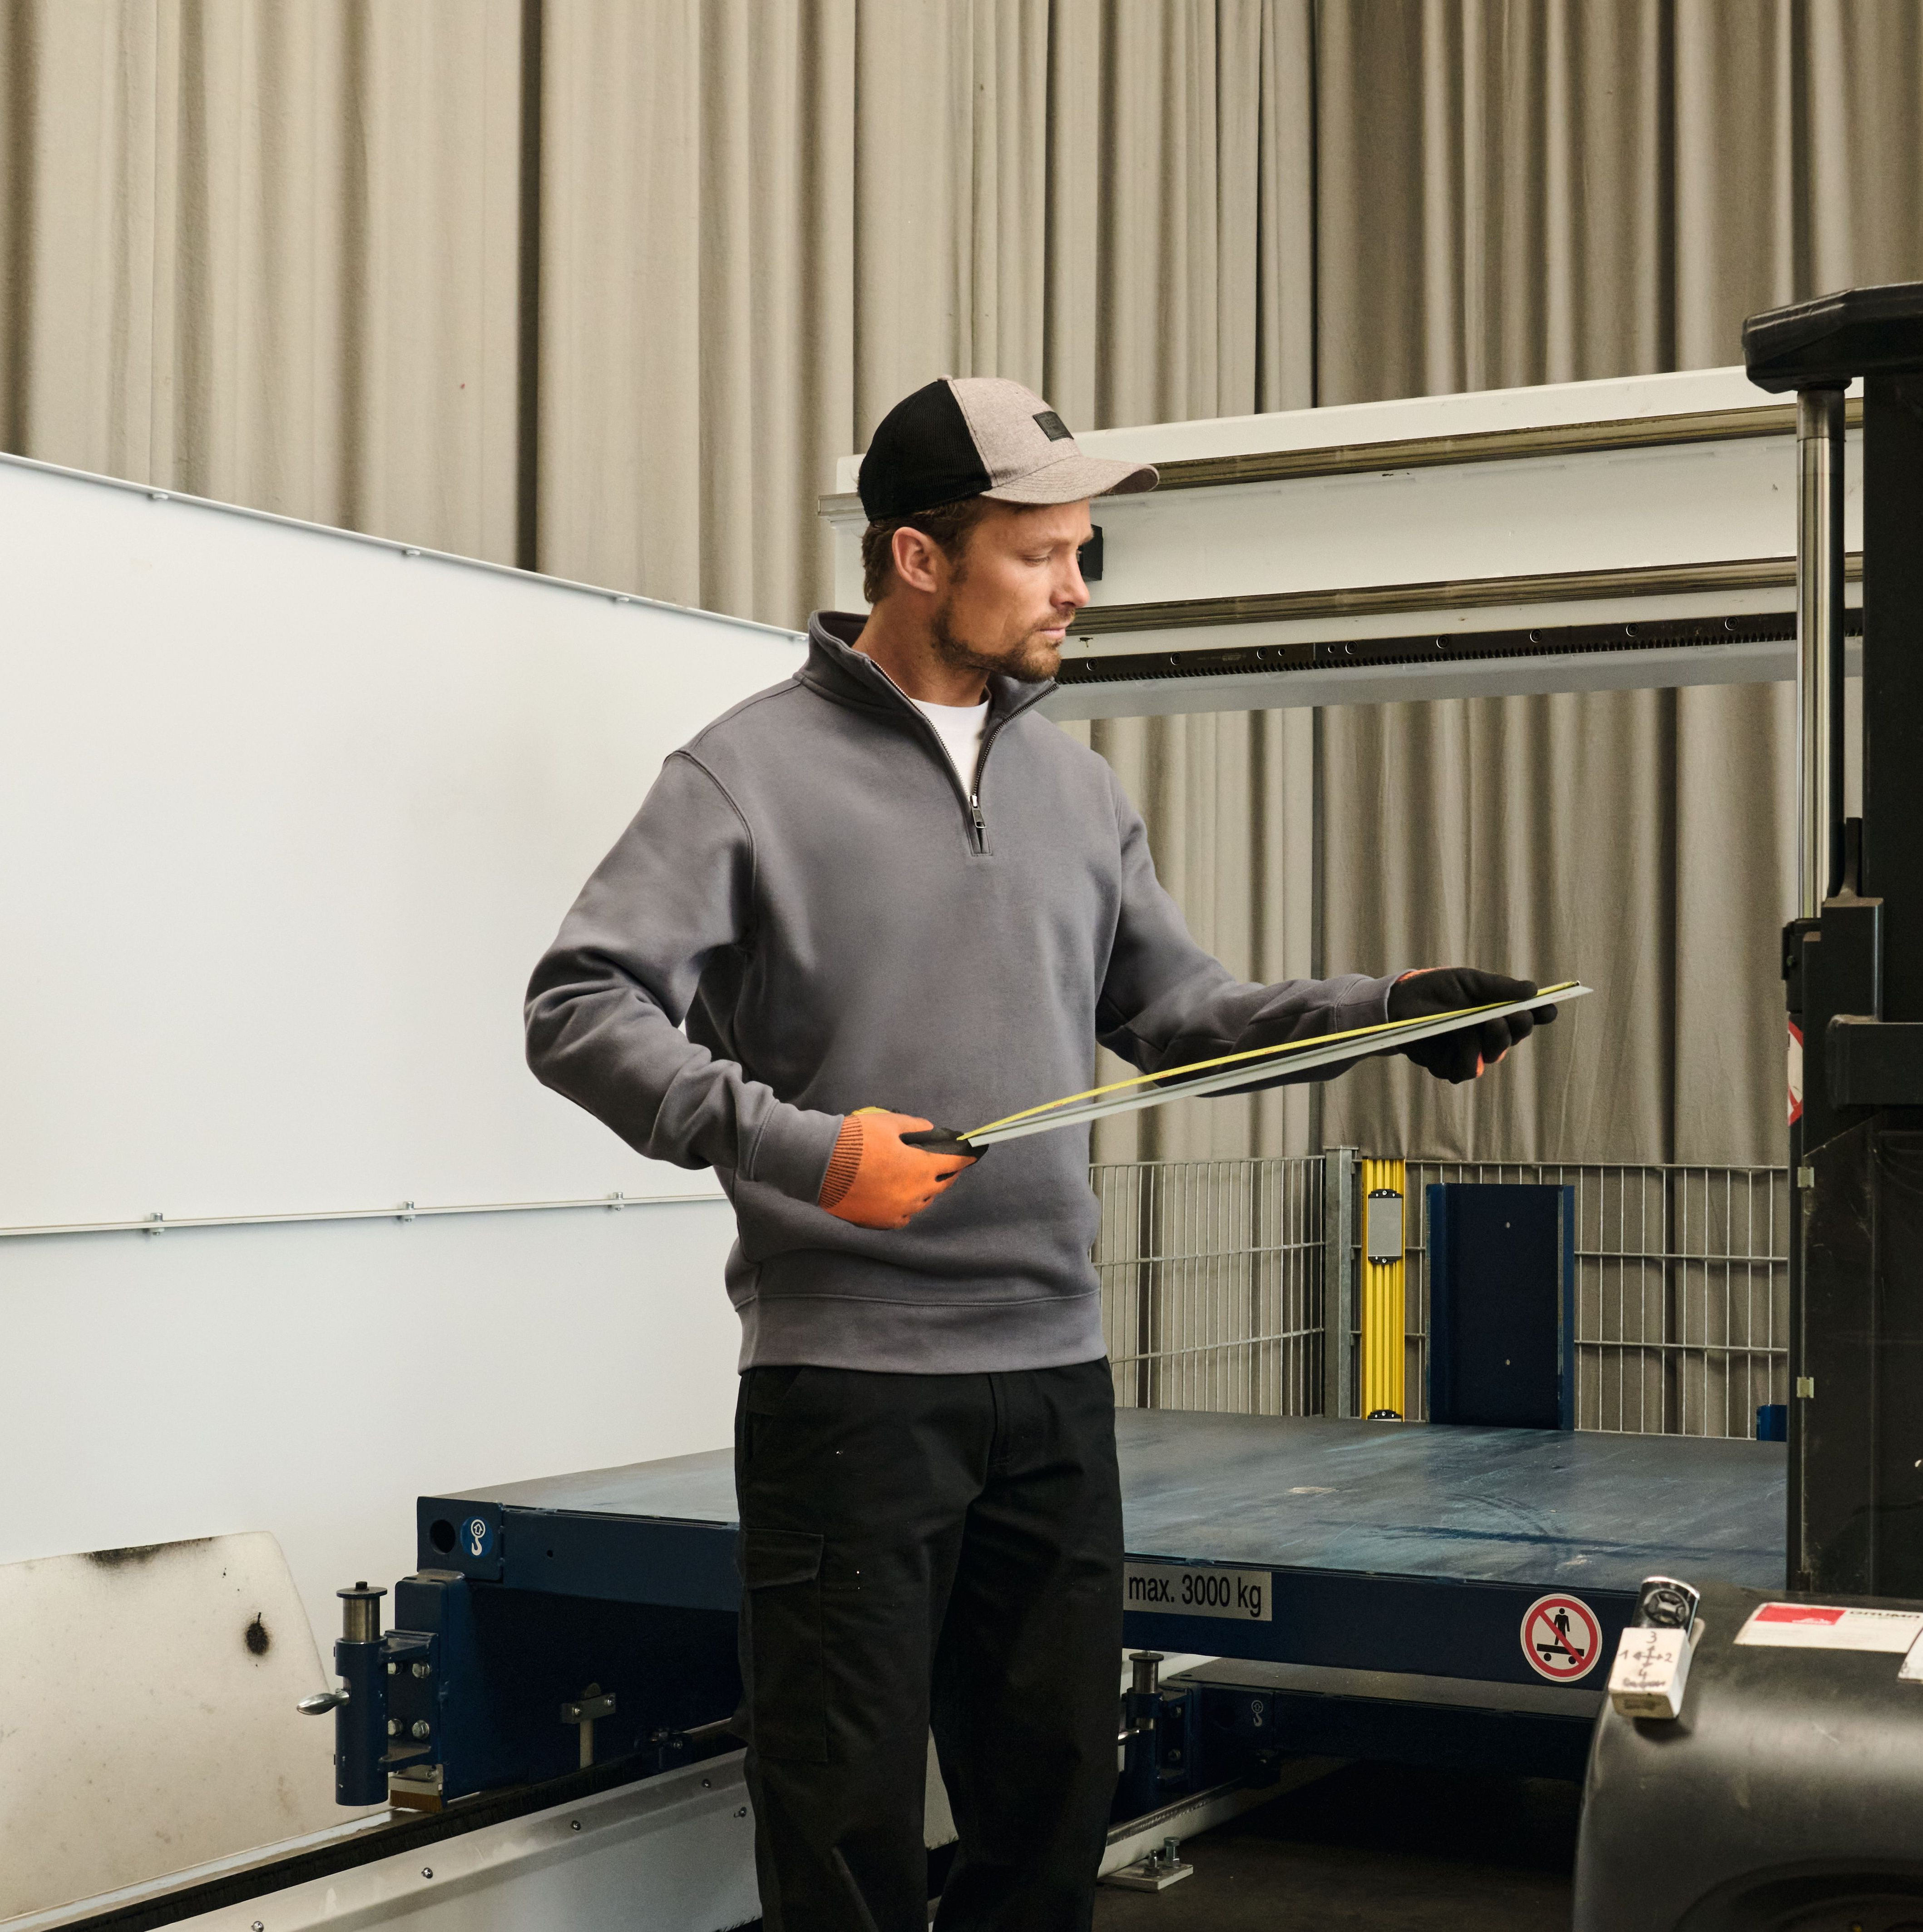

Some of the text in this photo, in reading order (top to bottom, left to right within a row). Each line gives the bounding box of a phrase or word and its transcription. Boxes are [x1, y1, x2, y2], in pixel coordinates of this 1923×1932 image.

[1129, 1574, 1261, 1617] max. 3000 kg
[1646, 1631, 1657, 1643] 3
[1619, 1650, 1628, 1660] 1
[1664, 1653, 1673, 1662] 2
[1638, 1669, 1647, 1679] 4
